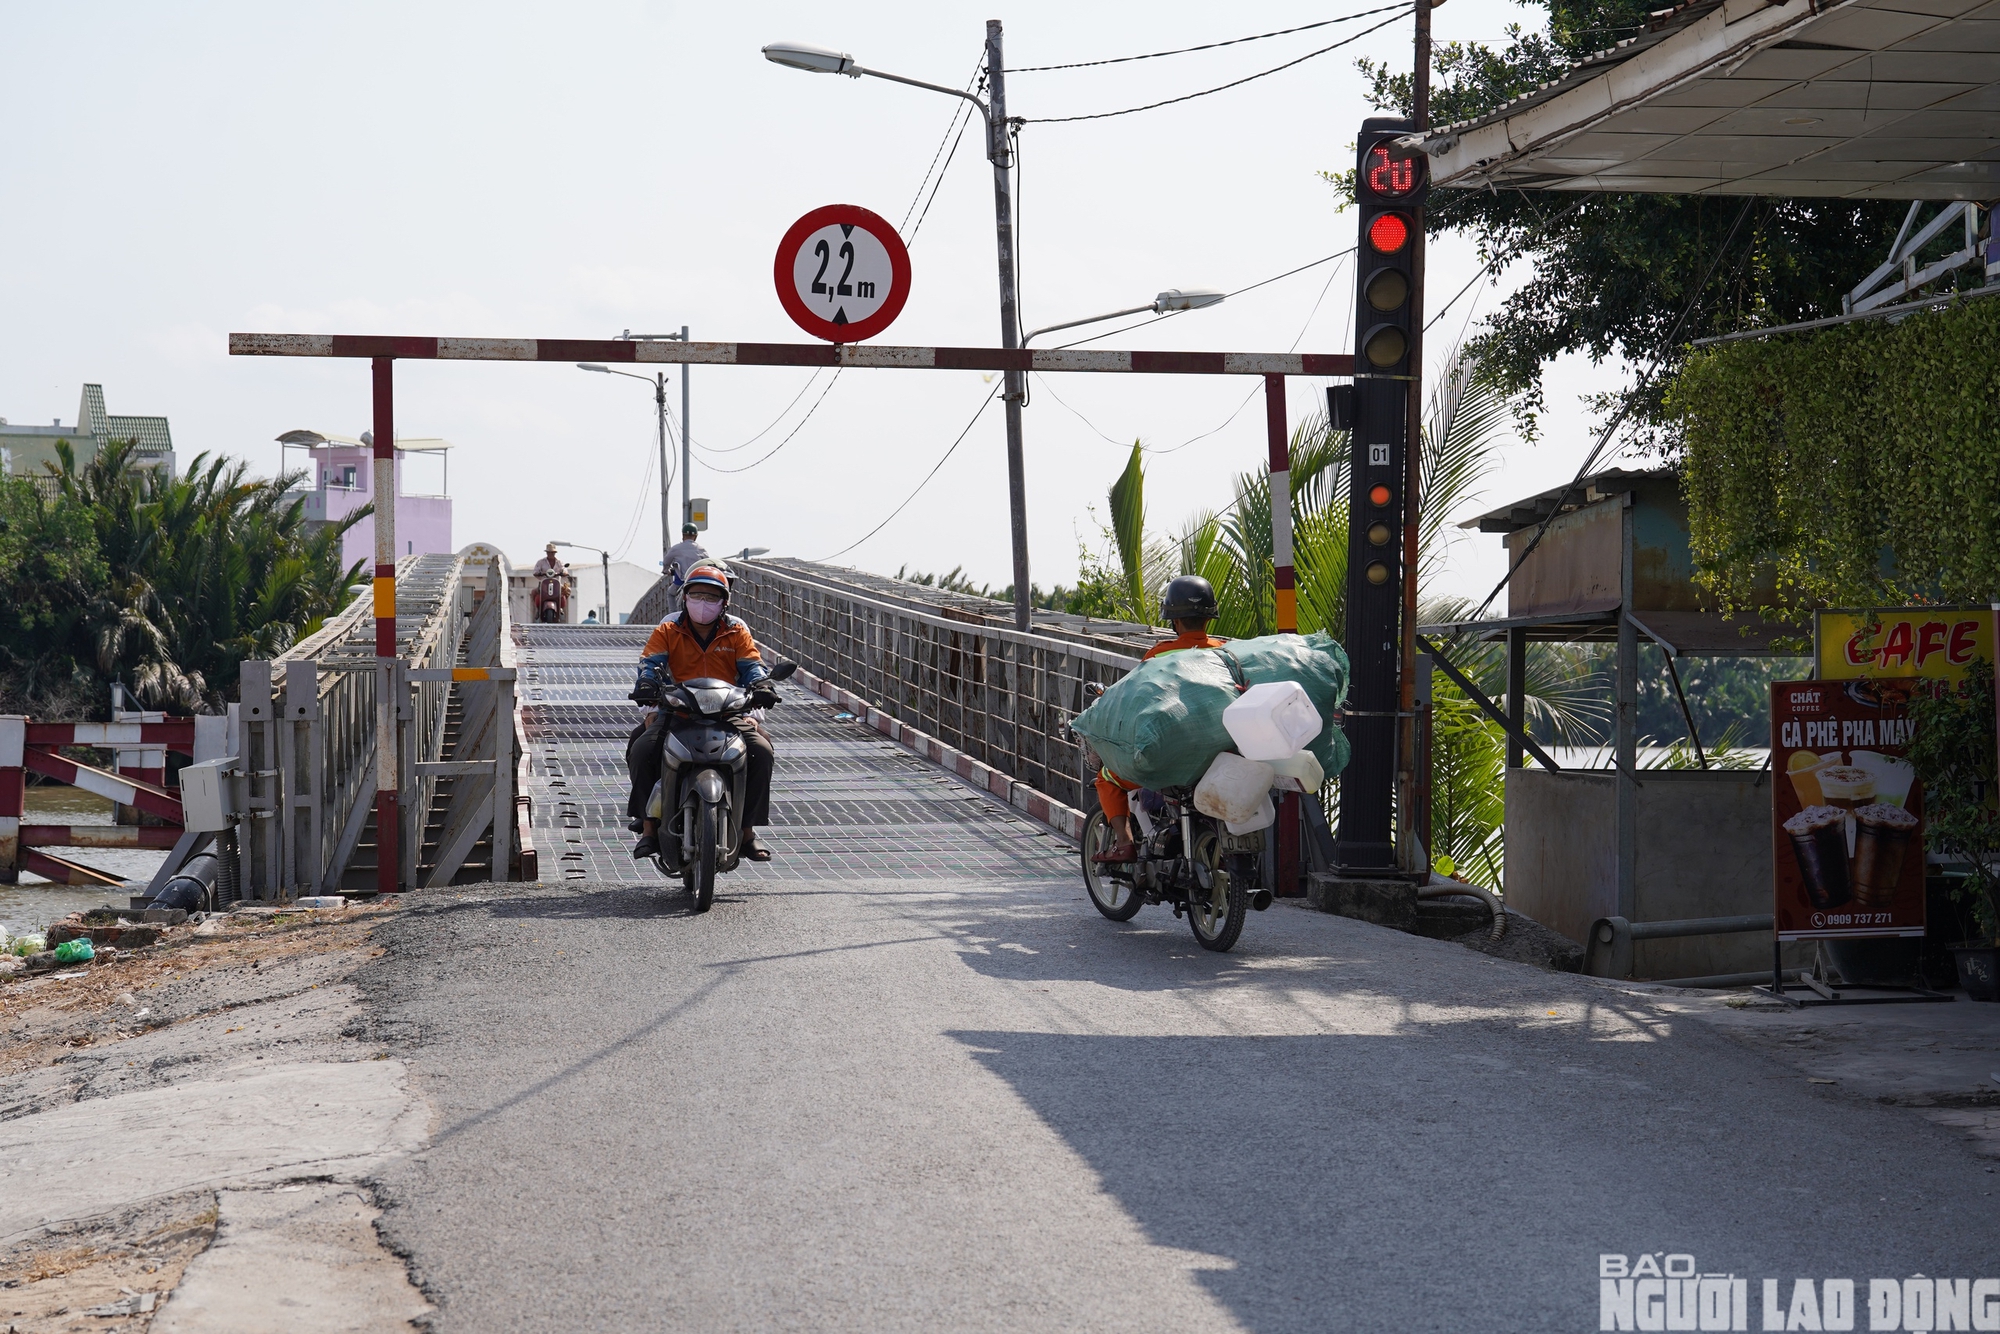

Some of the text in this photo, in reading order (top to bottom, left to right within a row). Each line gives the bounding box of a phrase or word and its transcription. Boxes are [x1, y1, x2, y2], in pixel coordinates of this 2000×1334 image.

[1372, 447, 1387, 462] 01
[1844, 620, 1980, 670] CAFE
[1790, 689, 1821, 704] CHẤT
[1781, 714, 1917, 748] CÀ PHÊ PHA MÁY
[1827, 912, 1892, 925] 0909 737 271
